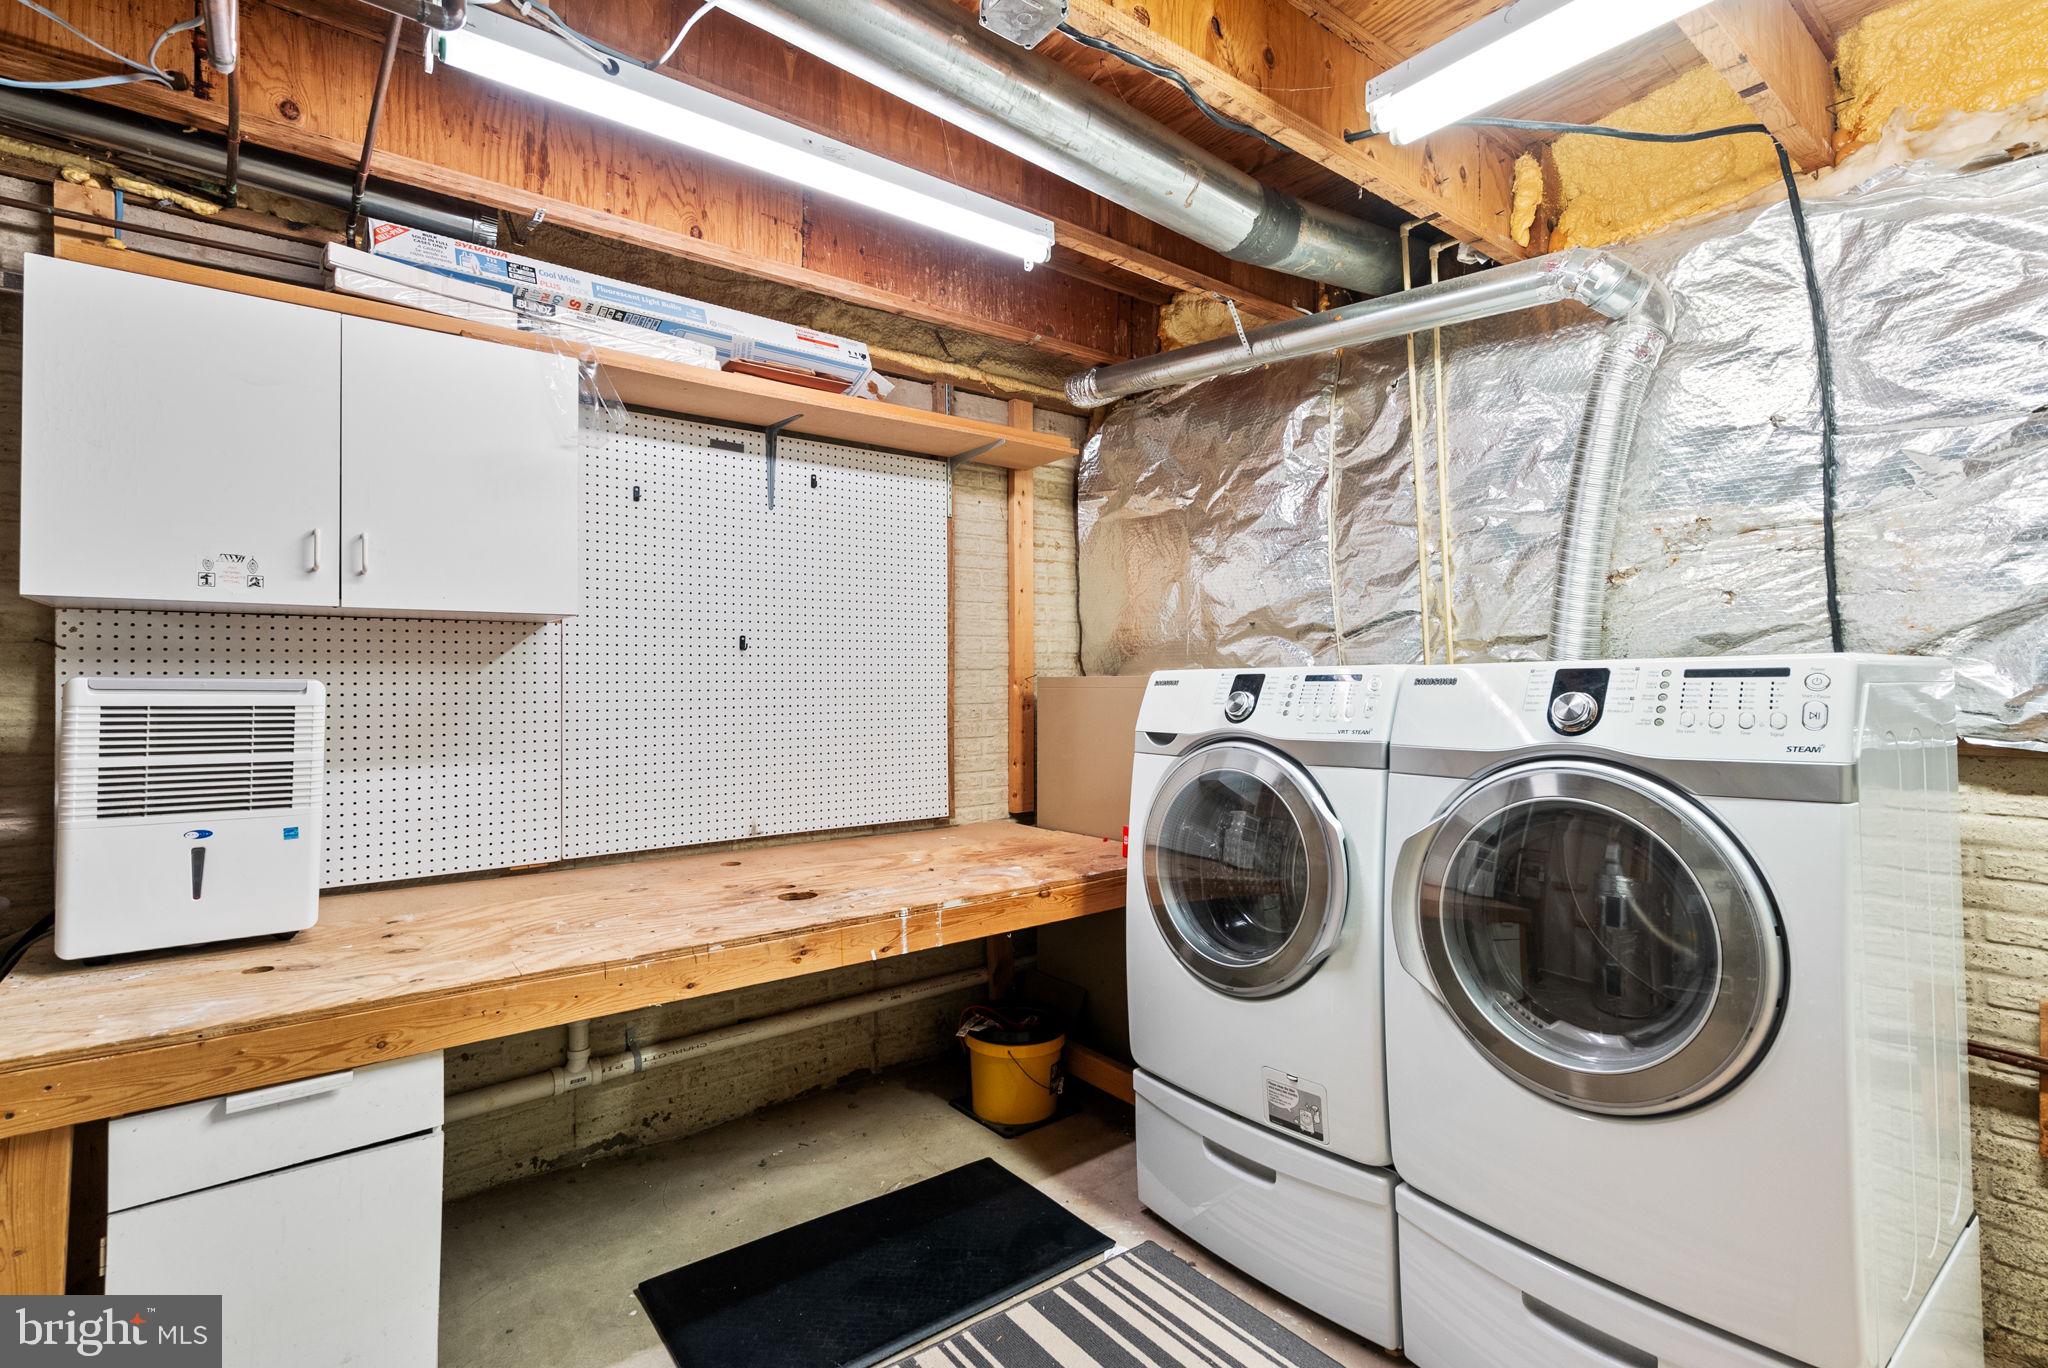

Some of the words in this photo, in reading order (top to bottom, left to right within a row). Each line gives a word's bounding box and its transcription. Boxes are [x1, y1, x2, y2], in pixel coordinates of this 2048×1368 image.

[411, 233, 427, 241] SOLD
[435, 239, 449, 247] FULL
[422, 232, 437, 240] BULK
[413, 238, 431, 247] CASES
[454, 240, 509, 259] SYLVANIA
[538, 269, 557, 280] Cool
[558, 273, 580, 285] White
[540, 280, 561, 291] PLUS
[596, 285, 641, 302] Fluorescent
[641, 296, 661, 307] Light
[660, 300, 682, 312] Bulbs
[1414, 677, 1458, 686] SAMSUNG
[1786, 745, 1822, 753] STEAM
